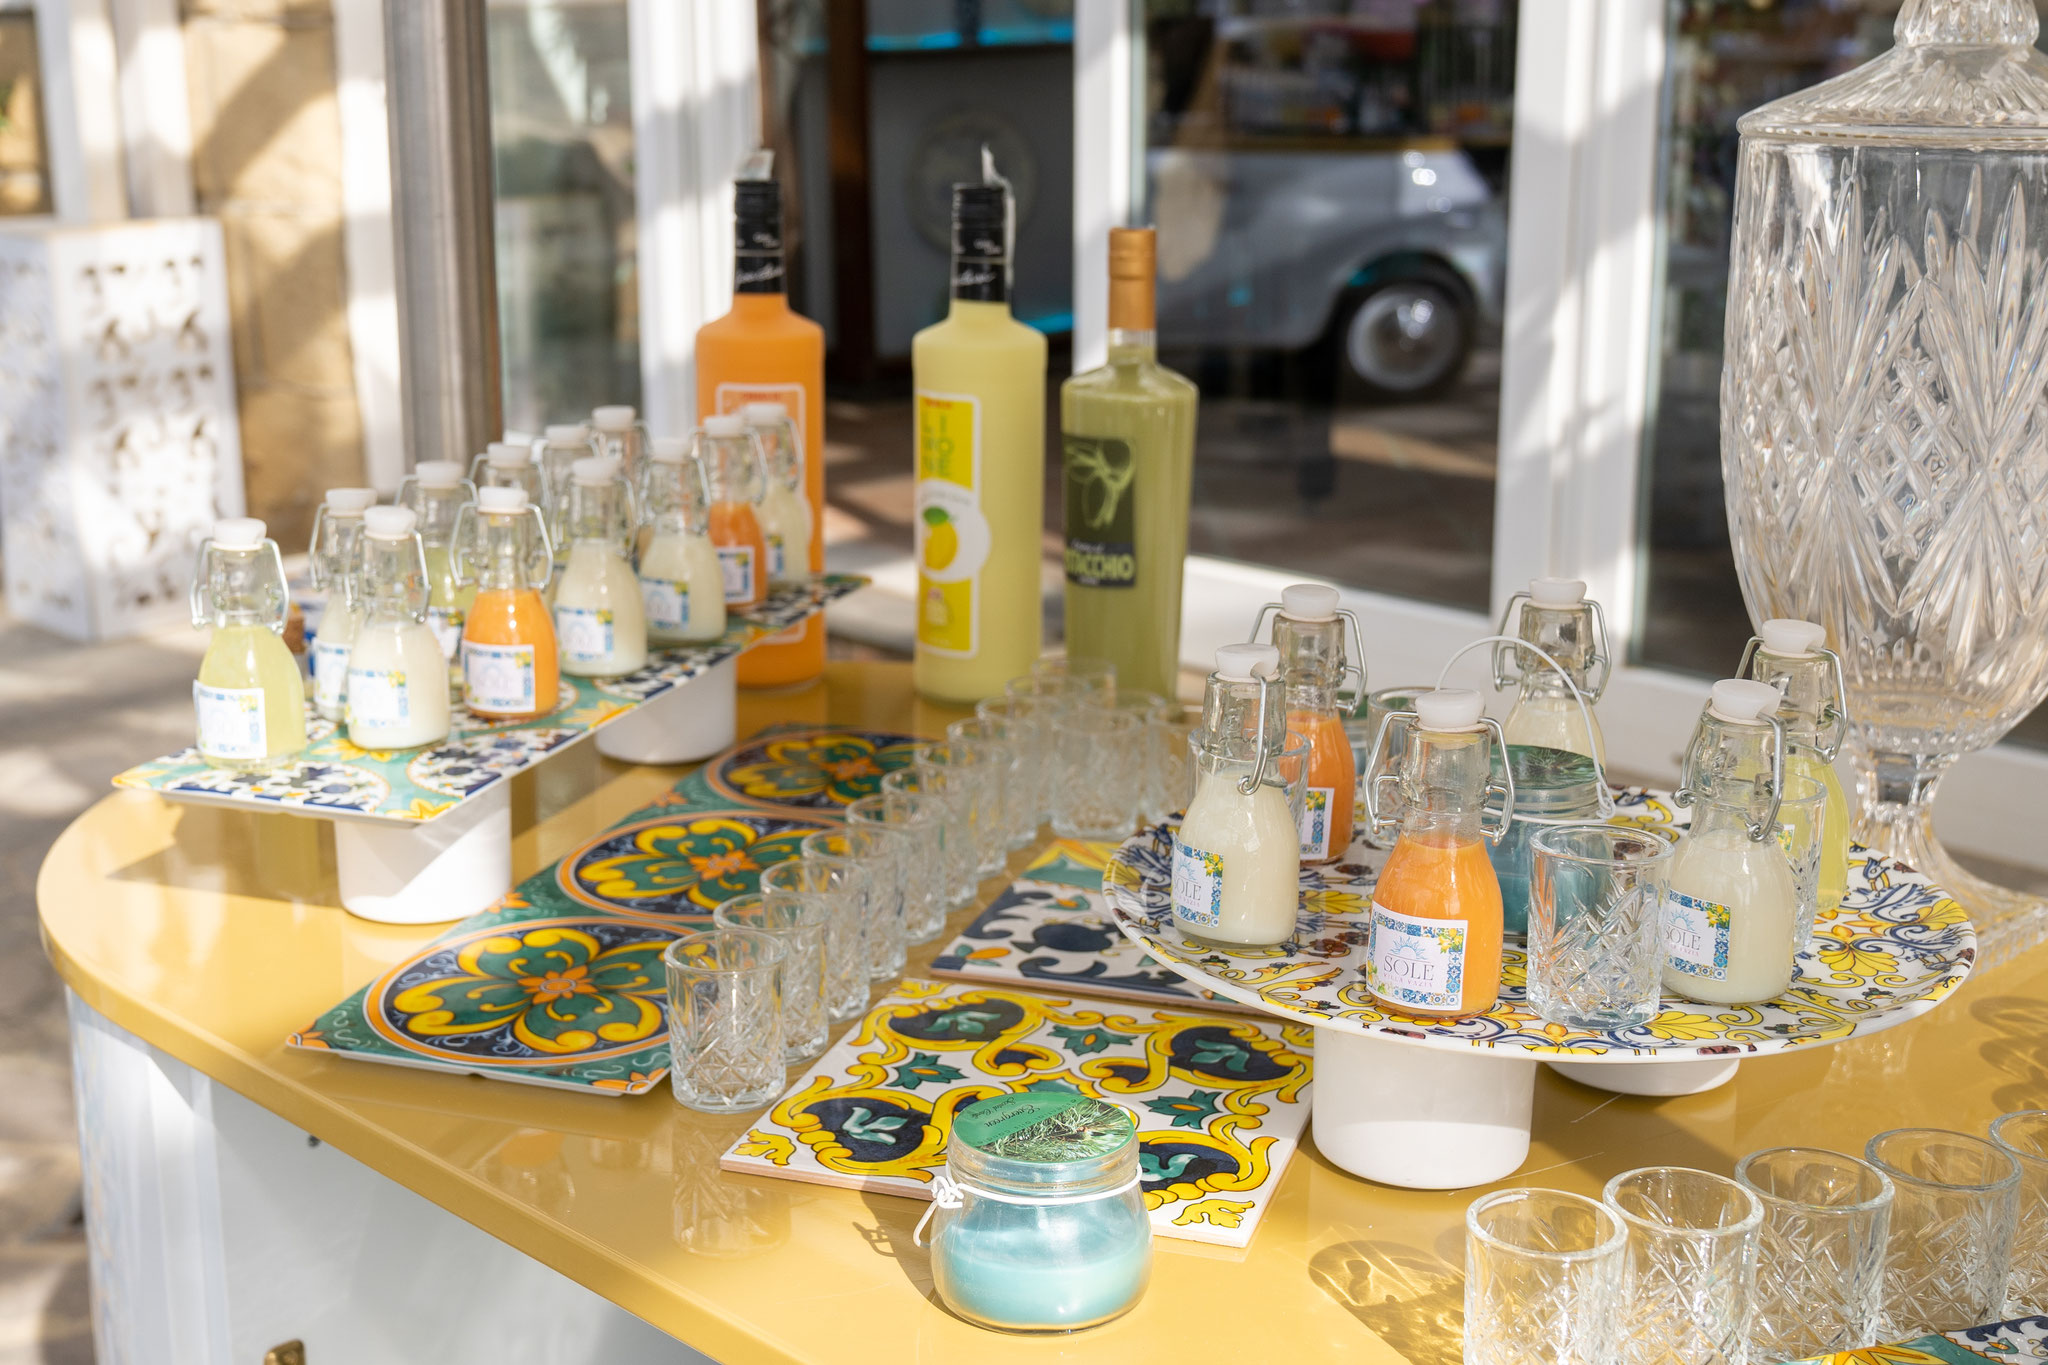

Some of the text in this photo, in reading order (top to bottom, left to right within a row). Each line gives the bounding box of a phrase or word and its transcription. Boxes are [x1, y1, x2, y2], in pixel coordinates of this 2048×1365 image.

[1665, 924, 1701, 950] SOLE
[1383, 955, 1434, 981] SOLE
[984, 1103, 1040, 1127] Evergreen
